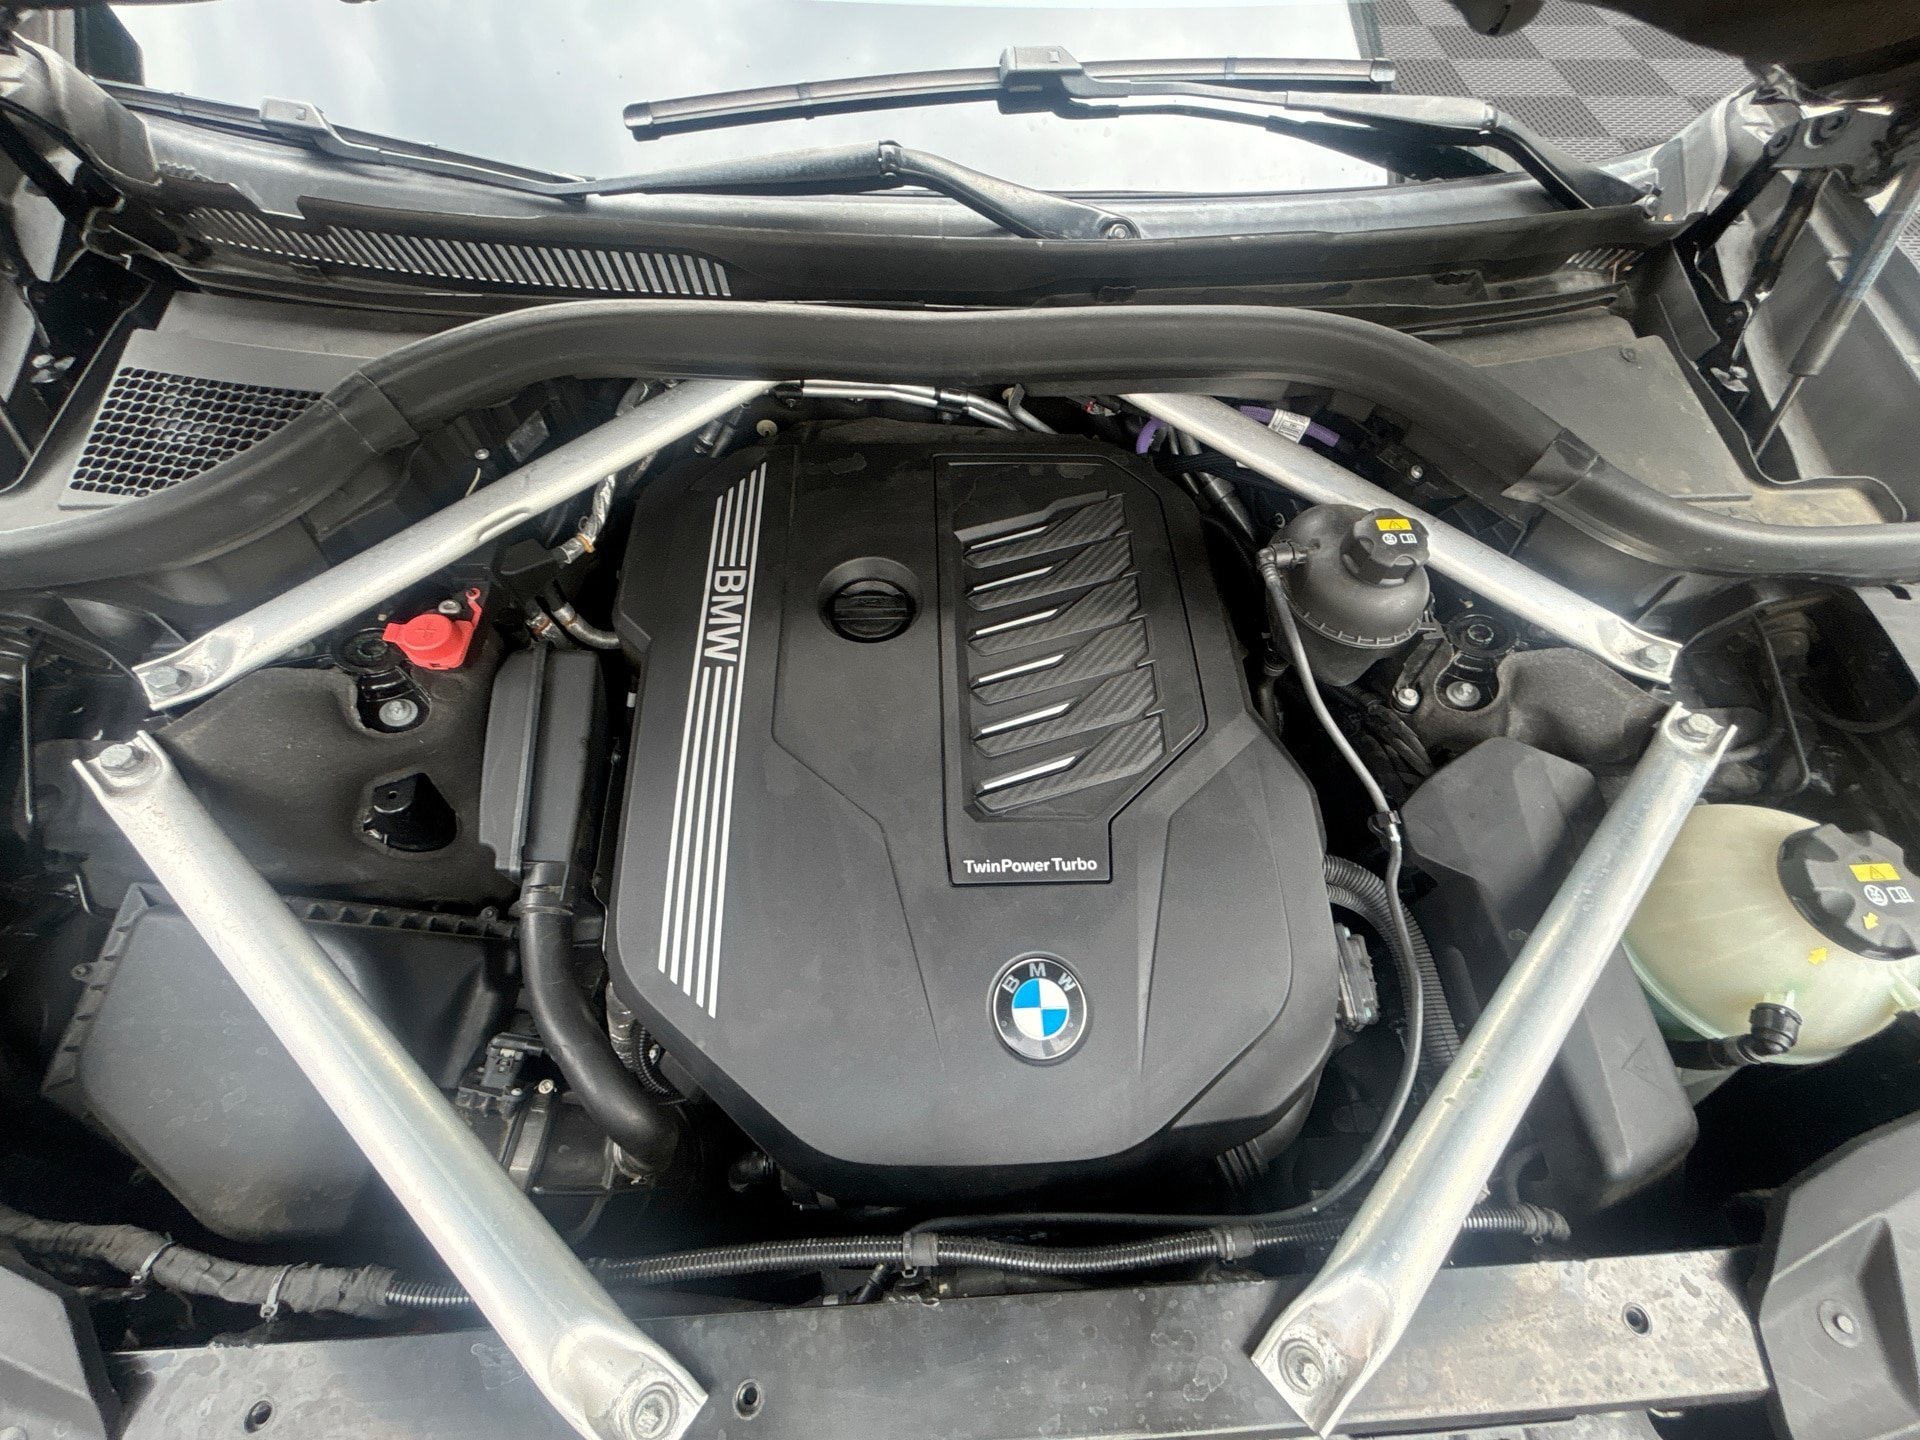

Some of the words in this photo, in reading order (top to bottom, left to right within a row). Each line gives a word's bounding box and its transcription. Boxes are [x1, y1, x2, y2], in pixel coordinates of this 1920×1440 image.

[704, 570, 747, 662] BMW
[1051, 857, 1097, 871] Turbo
[1002, 962, 1076, 994] BMW
